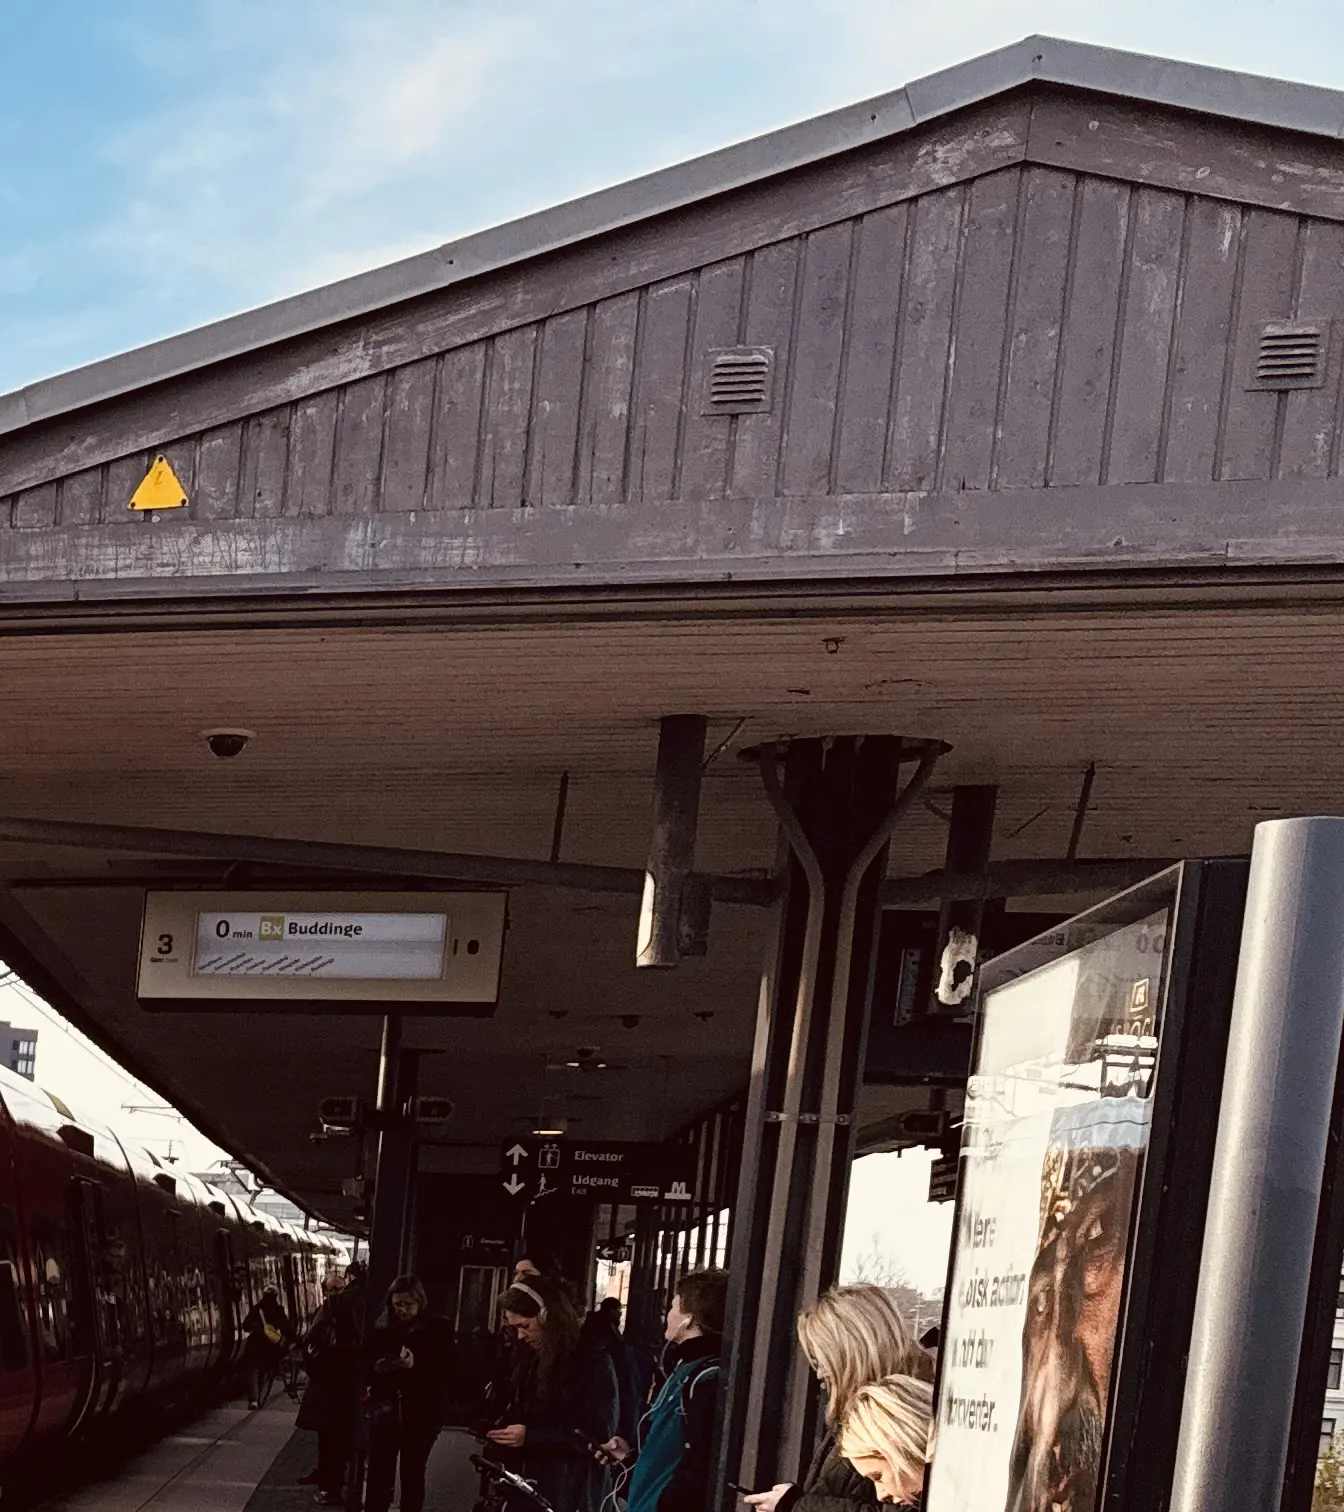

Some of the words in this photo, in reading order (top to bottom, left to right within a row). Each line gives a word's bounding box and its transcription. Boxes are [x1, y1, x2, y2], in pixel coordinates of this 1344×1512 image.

[215, 919, 230, 939] 0
[232, 929, 253, 939] min
[260, 921, 283, 936] Bx
[287, 922, 363, 939] Buddinge
[156, 934, 174, 955] 3
[574, 1150, 625, 1162] Elevator
[572, 1175, 619, 1187] Udgang
